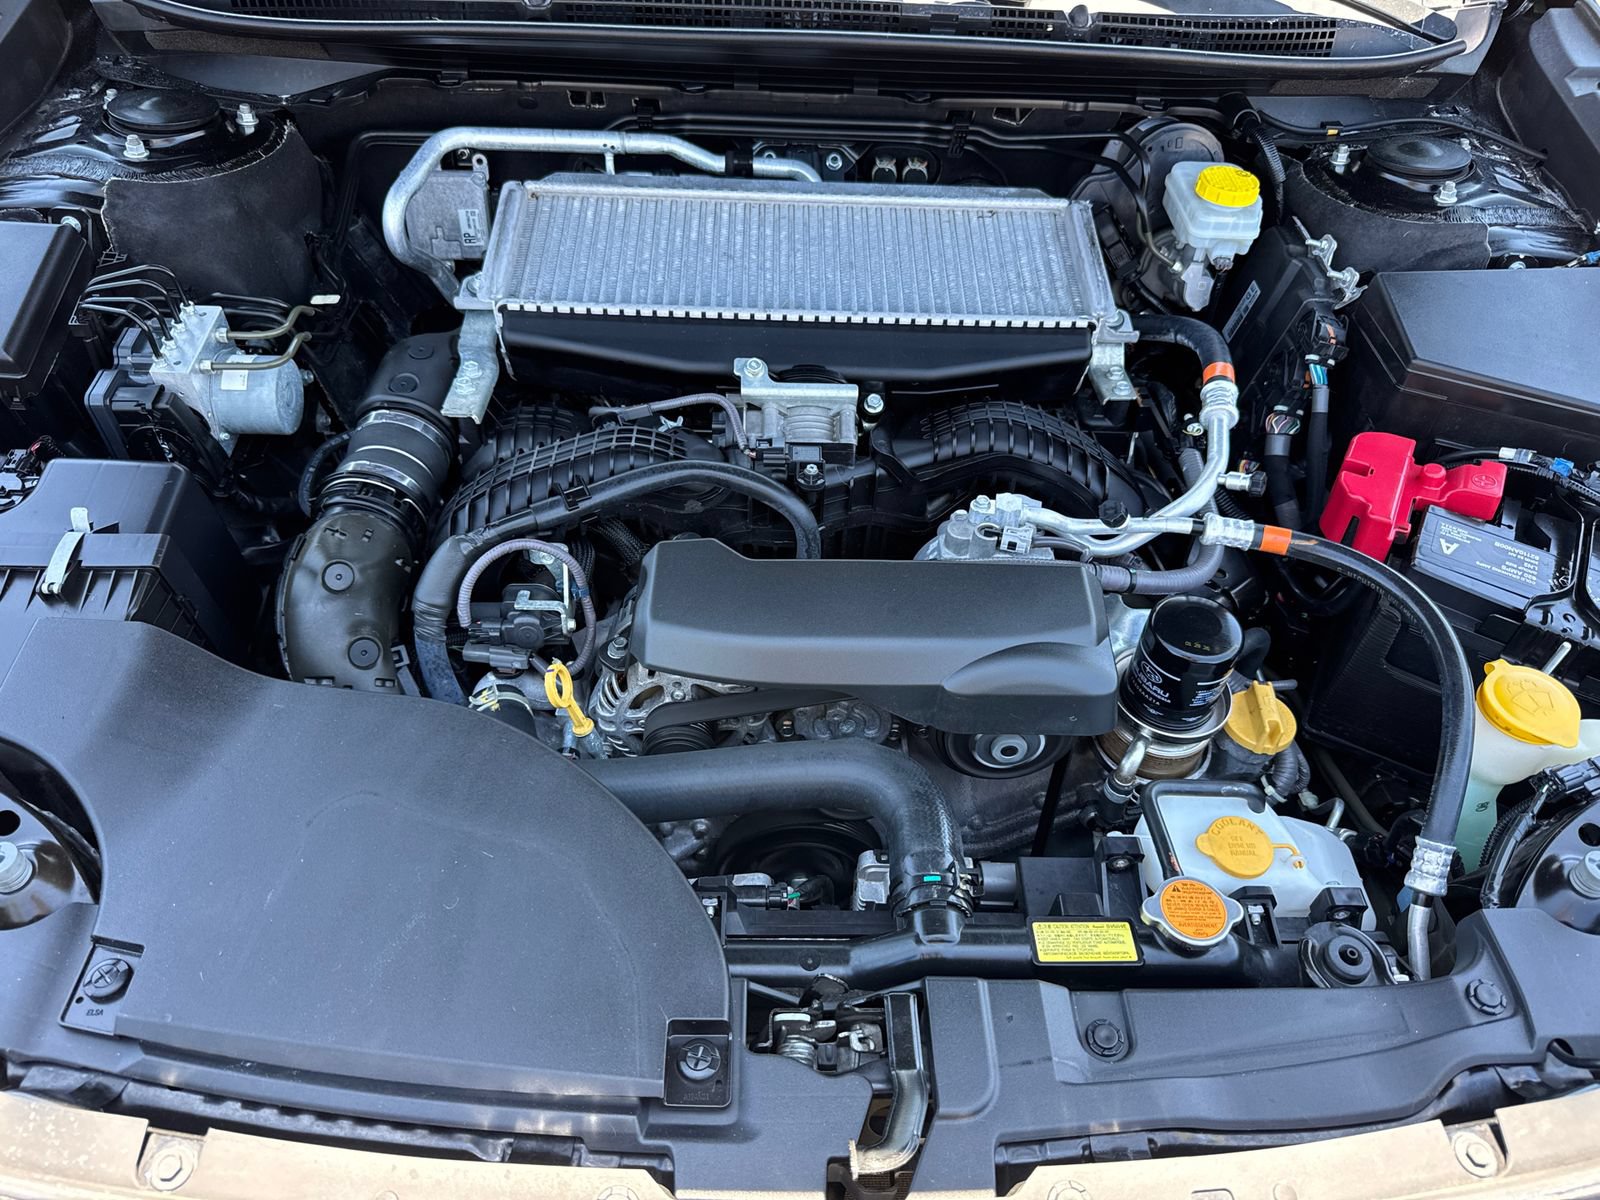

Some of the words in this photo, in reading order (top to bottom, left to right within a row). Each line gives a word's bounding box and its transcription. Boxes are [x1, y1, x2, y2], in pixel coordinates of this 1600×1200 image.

[463, 232, 476, 243] RP
[1439, 538, 1460, 555] A
[1501, 565, 1522, 575] AMPS
[1211, 818, 1264, 836] COOLANT
